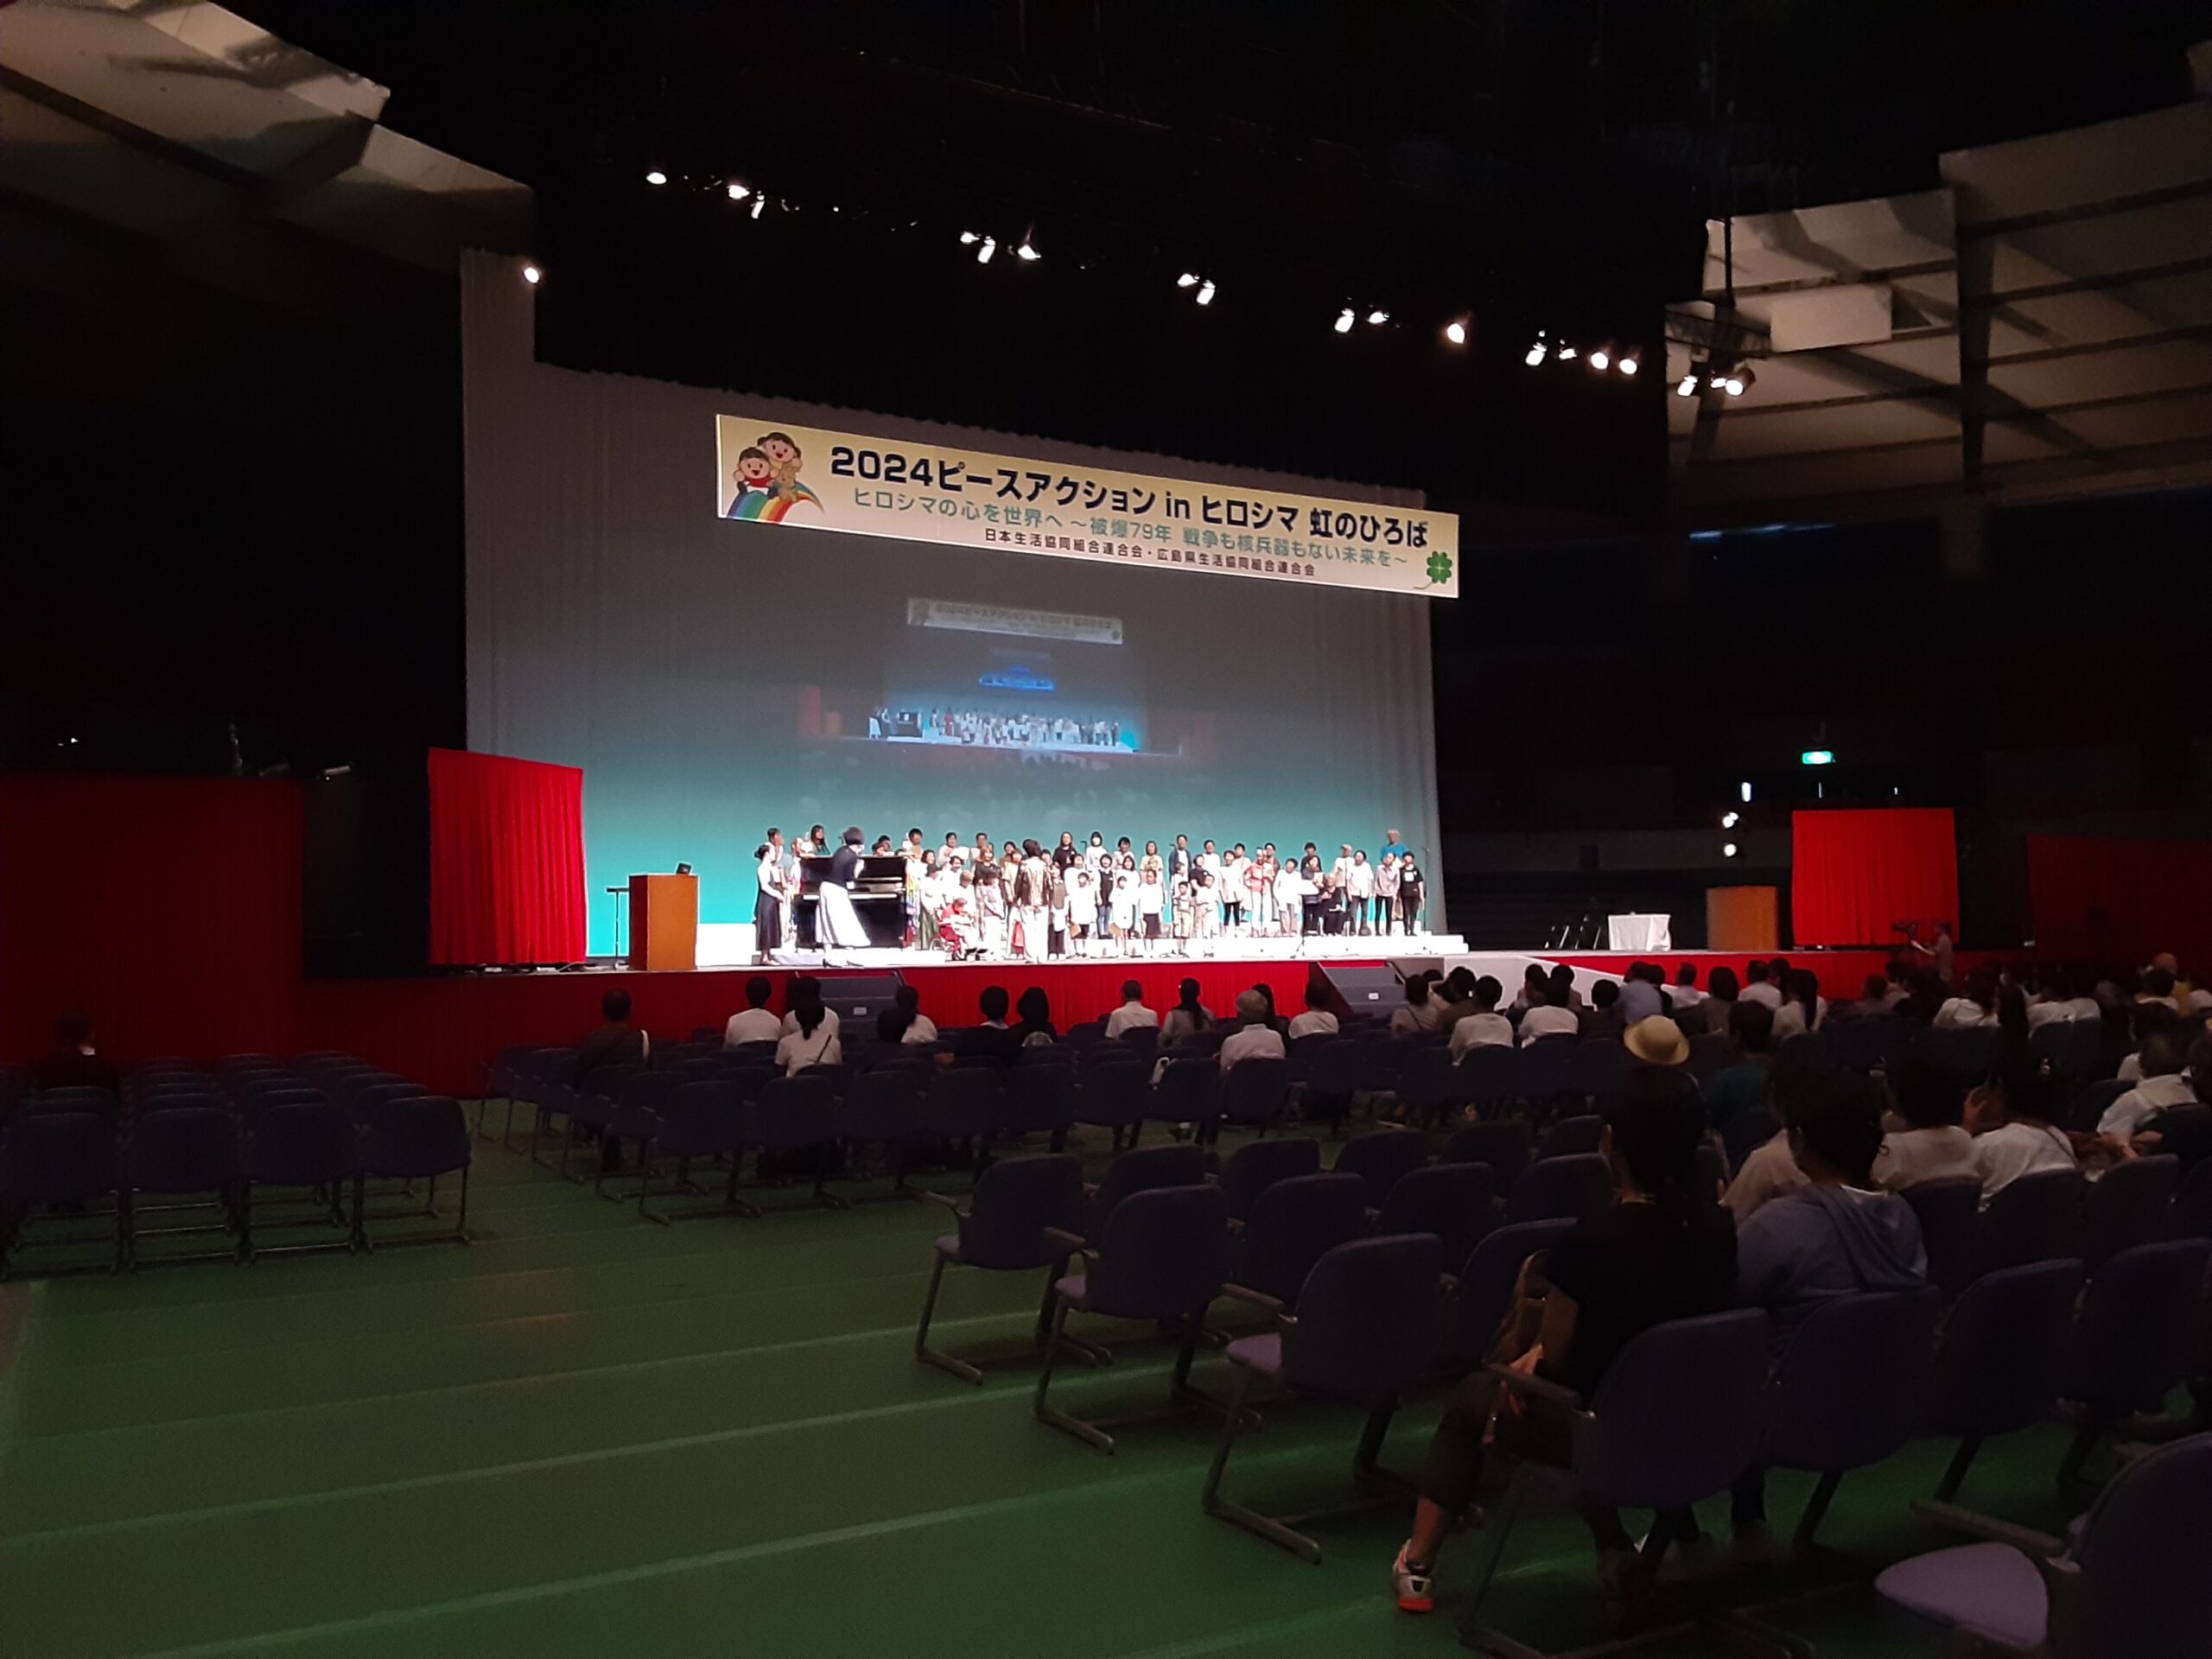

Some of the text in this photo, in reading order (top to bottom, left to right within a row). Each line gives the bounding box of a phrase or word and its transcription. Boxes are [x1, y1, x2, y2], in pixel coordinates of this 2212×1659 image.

[831, 447, 1428, 548] 2024ピースアクション in ヒロシマ 虹のひろば
[855, 487, 1063, 528] ヒロシマの心を世界へ
